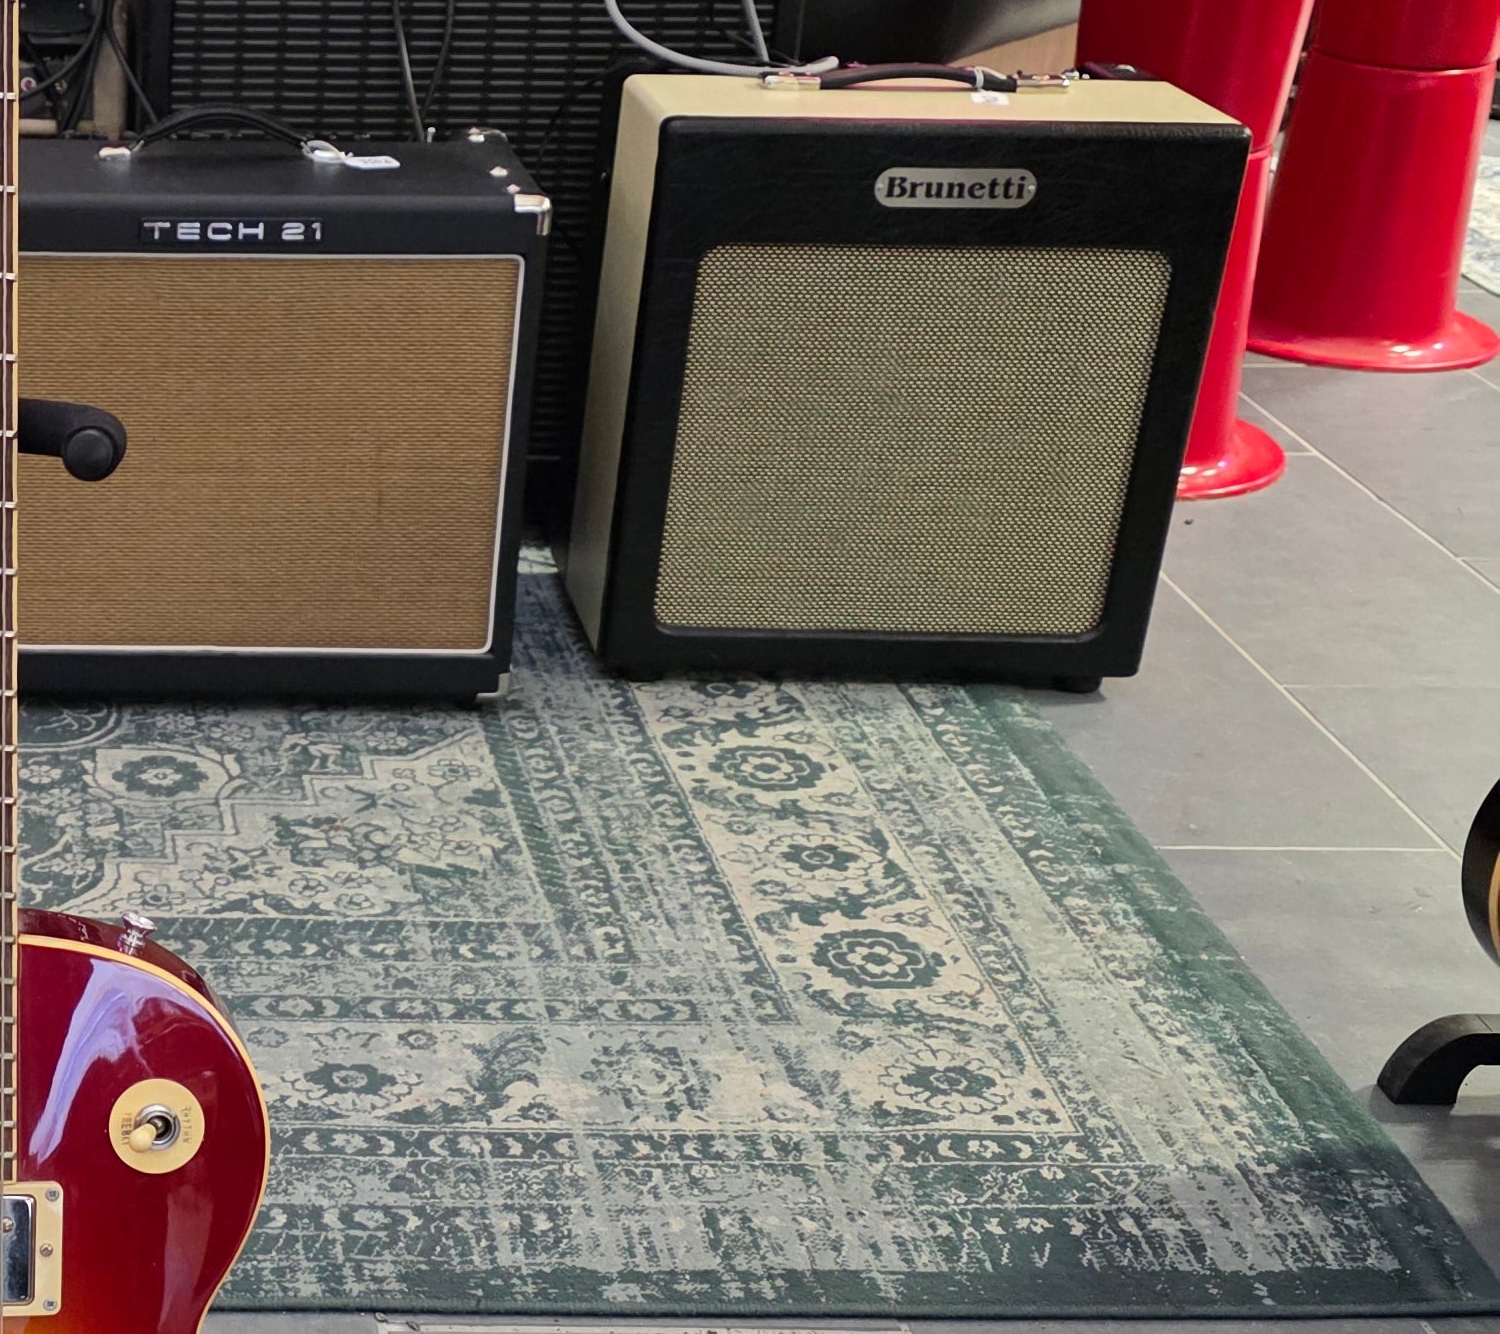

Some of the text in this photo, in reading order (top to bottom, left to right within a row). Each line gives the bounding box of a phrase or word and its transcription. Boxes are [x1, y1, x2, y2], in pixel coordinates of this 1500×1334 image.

[885, 175, 1027, 200] Brunetti
[143, 222, 322, 241] TECH 21
